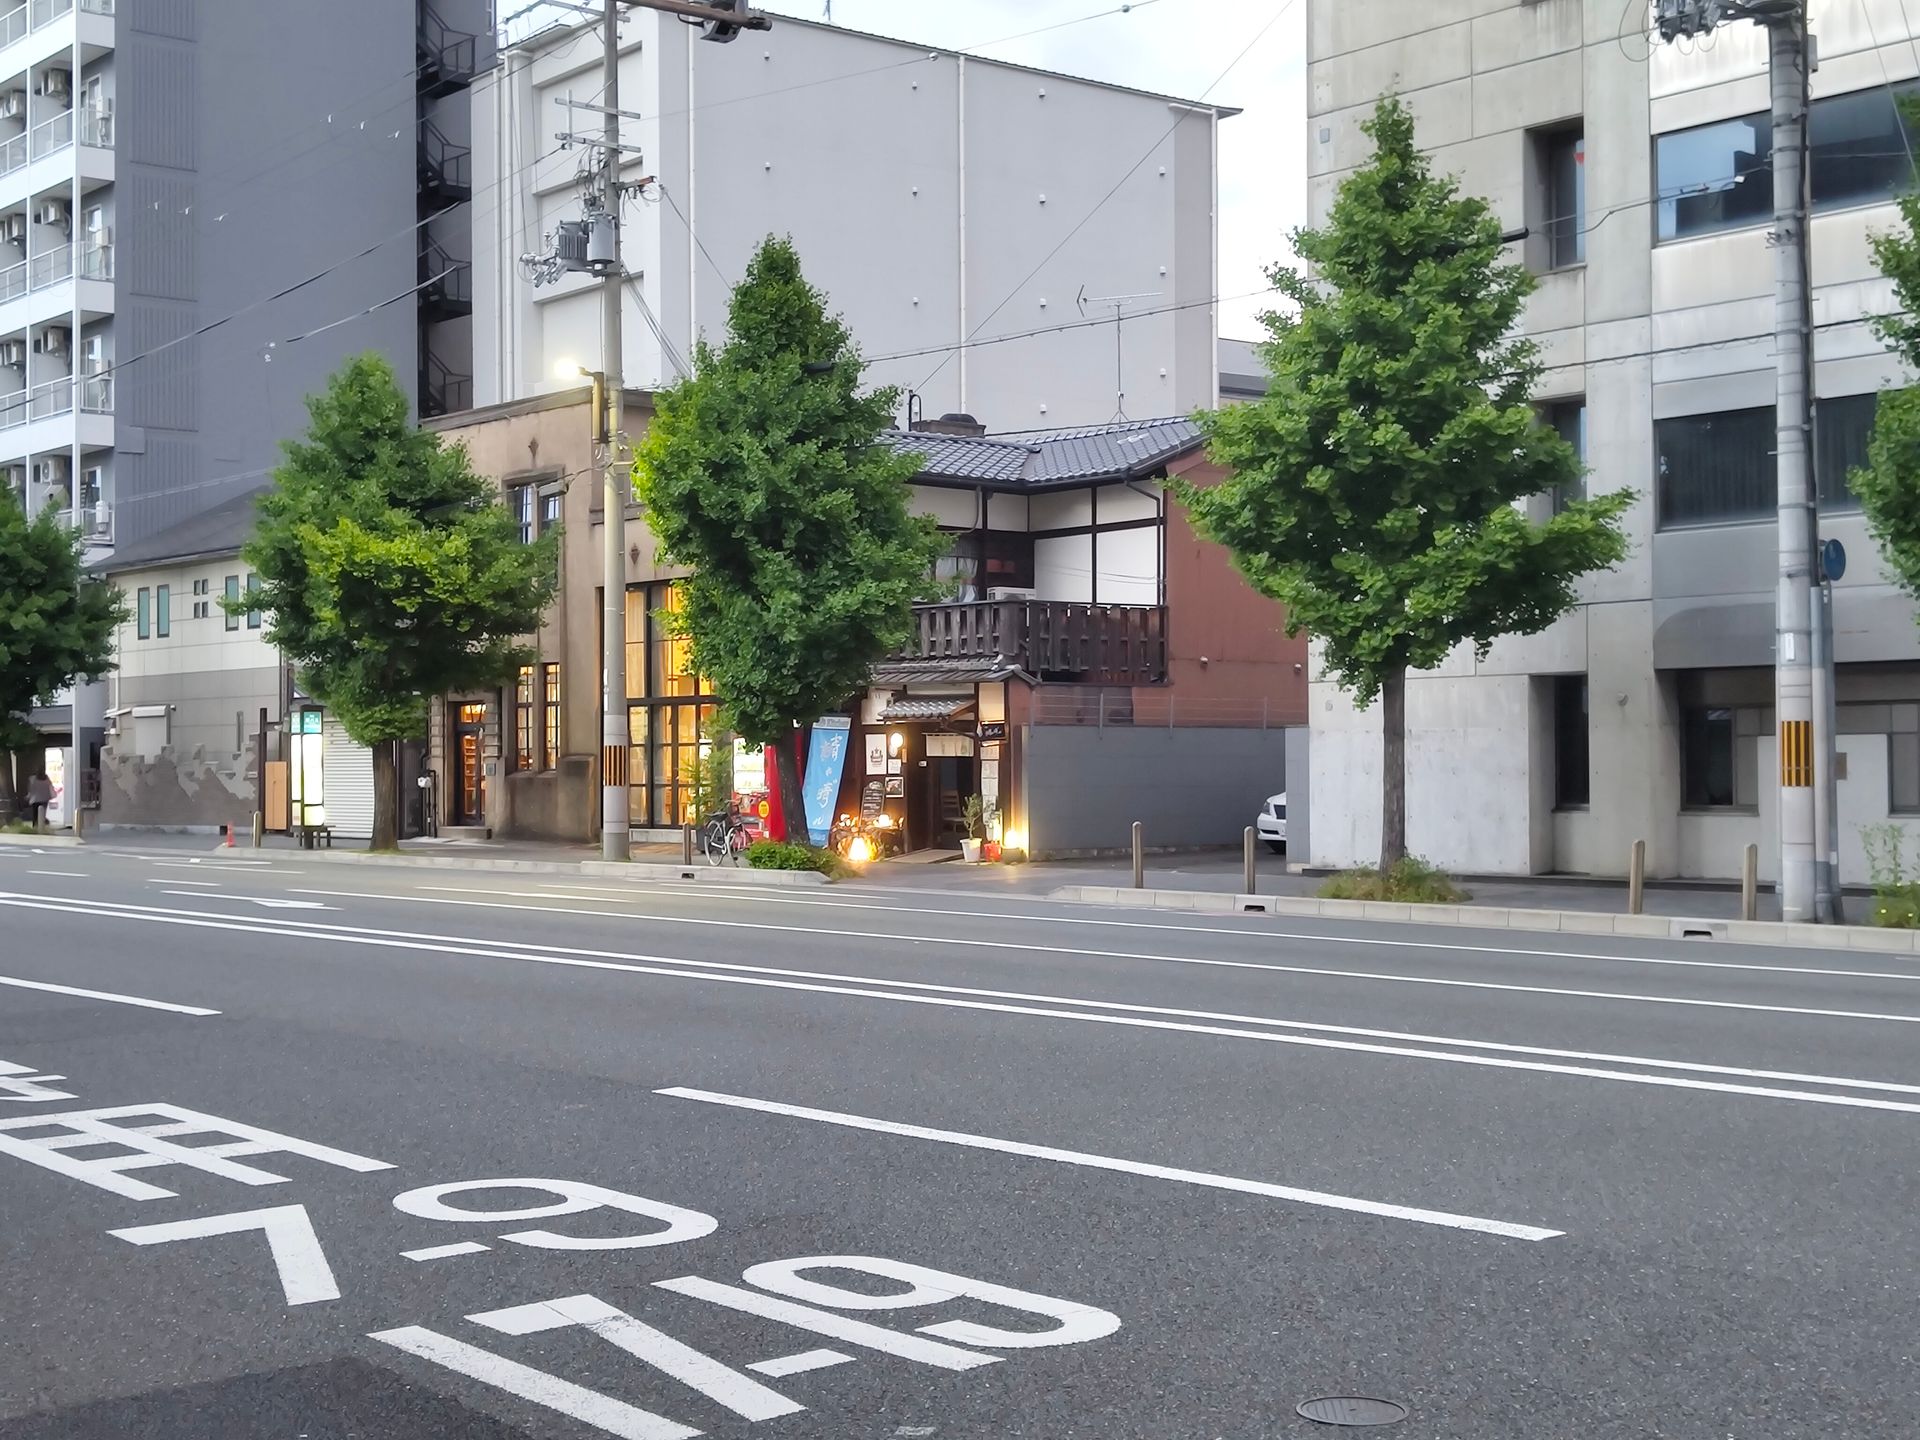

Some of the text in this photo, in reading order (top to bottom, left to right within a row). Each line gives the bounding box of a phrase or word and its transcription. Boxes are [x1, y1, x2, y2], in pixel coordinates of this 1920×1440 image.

[0, 1060, 398, 1202] 用
[106, 1178, 718, 1305] 7-9
[366, 1256, 1122, 1440] 17-19
